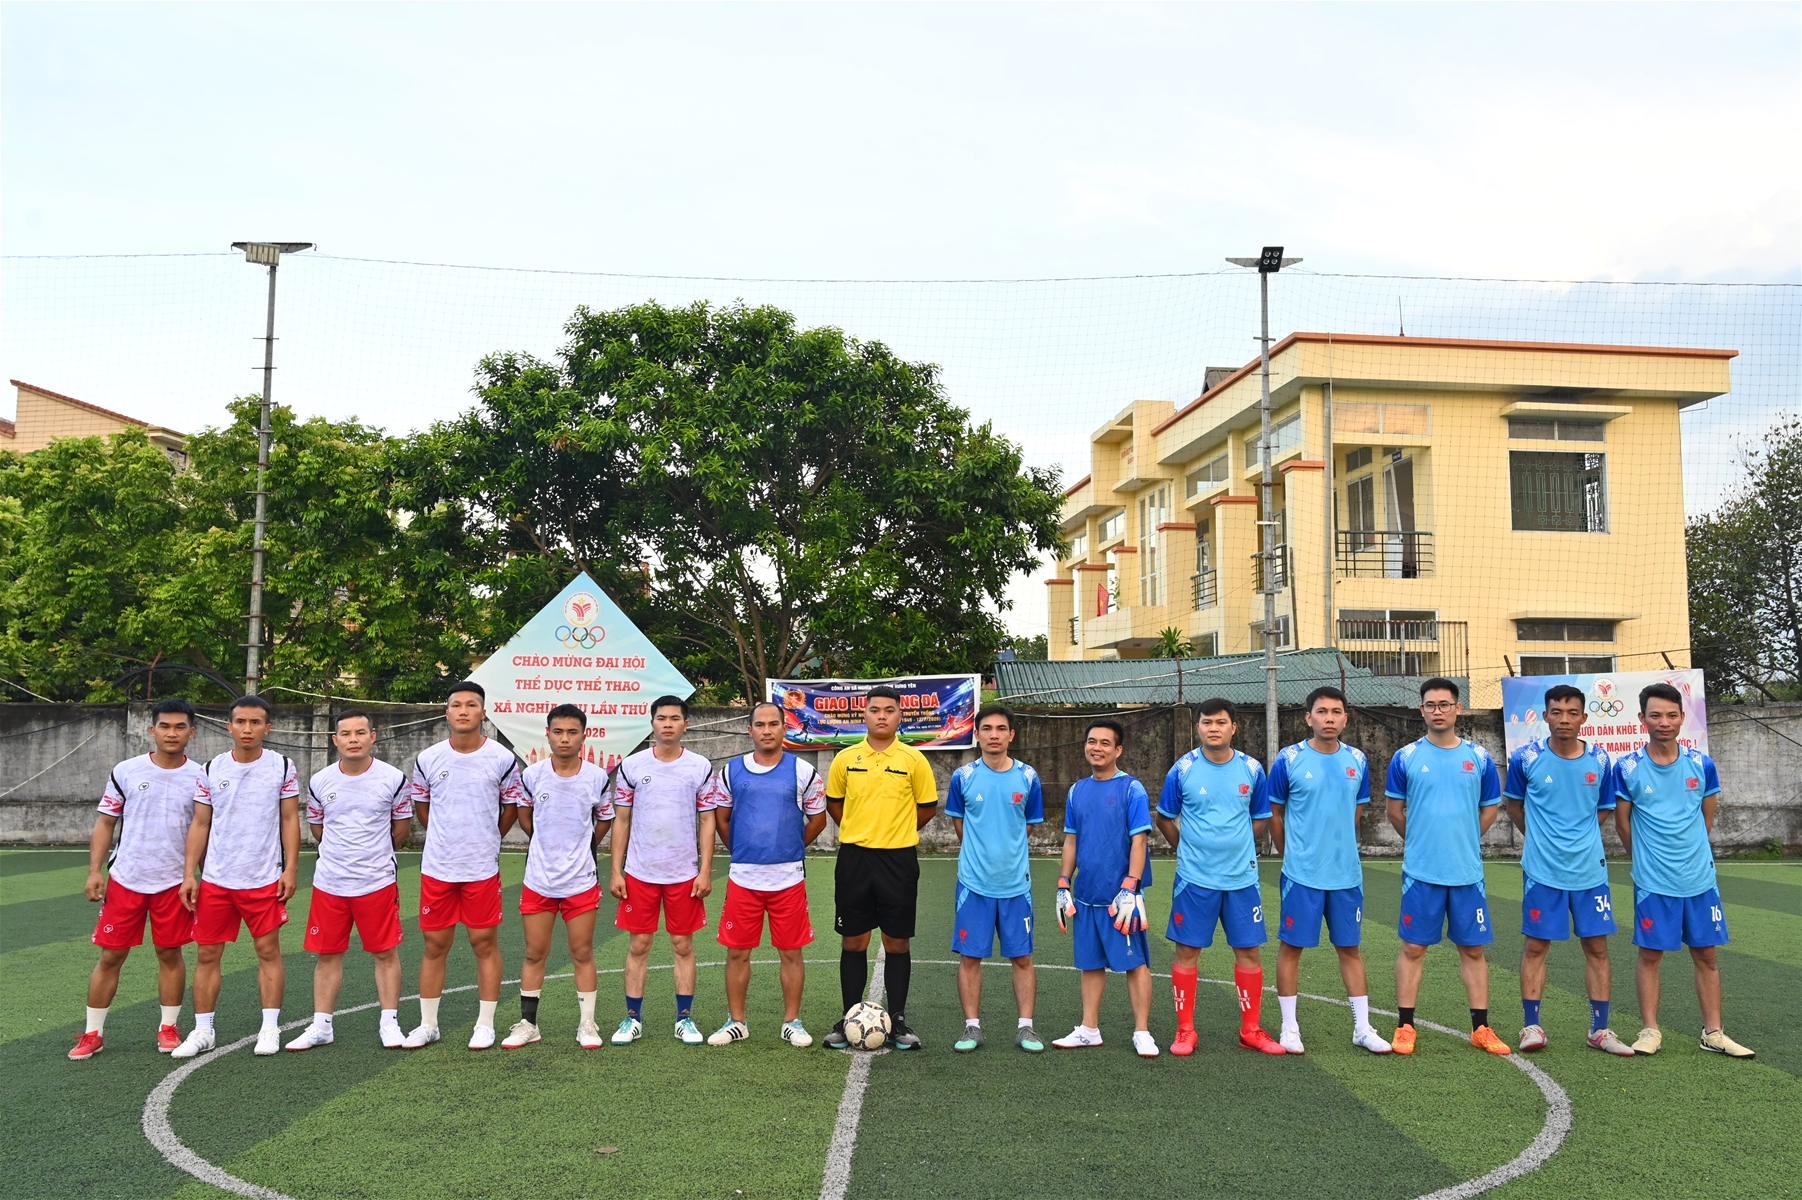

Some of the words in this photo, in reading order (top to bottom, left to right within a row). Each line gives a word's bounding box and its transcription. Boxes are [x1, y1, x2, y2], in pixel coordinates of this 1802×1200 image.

[512, 653, 550, 667] CHÀO
[552, 653, 593, 668] MỪNG
[595, 657, 620, 670] ĐẠI
[622, 655, 646, 671] HỘI
[515, 674, 541, 690] THỂ
[544, 680, 573, 693] DỤC
[576, 675, 602, 691] THỂ
[605, 681, 640, 691] THAO
[493, 700, 512, 713] XÃ
[591, 699, 618, 715] LẦN
[621, 701, 648, 715] THỨ
[814, 697, 848, 711] GIAO
[851, 696, 867, 711] LƯ
[900, 694, 920, 709] NG
[921, 692, 940, 708] ĐÁ
[585, 727, 605, 738] 026
[1577, 724, 1595, 736] ƯỜI
[1597, 723, 1614, 736] DÂN
[1607, 742, 1631, 754] MẠNH
[1594, 895, 1610, 912] 34
[1476, 908, 1484, 923] 8
[1711, 905, 1722, 921] 16
